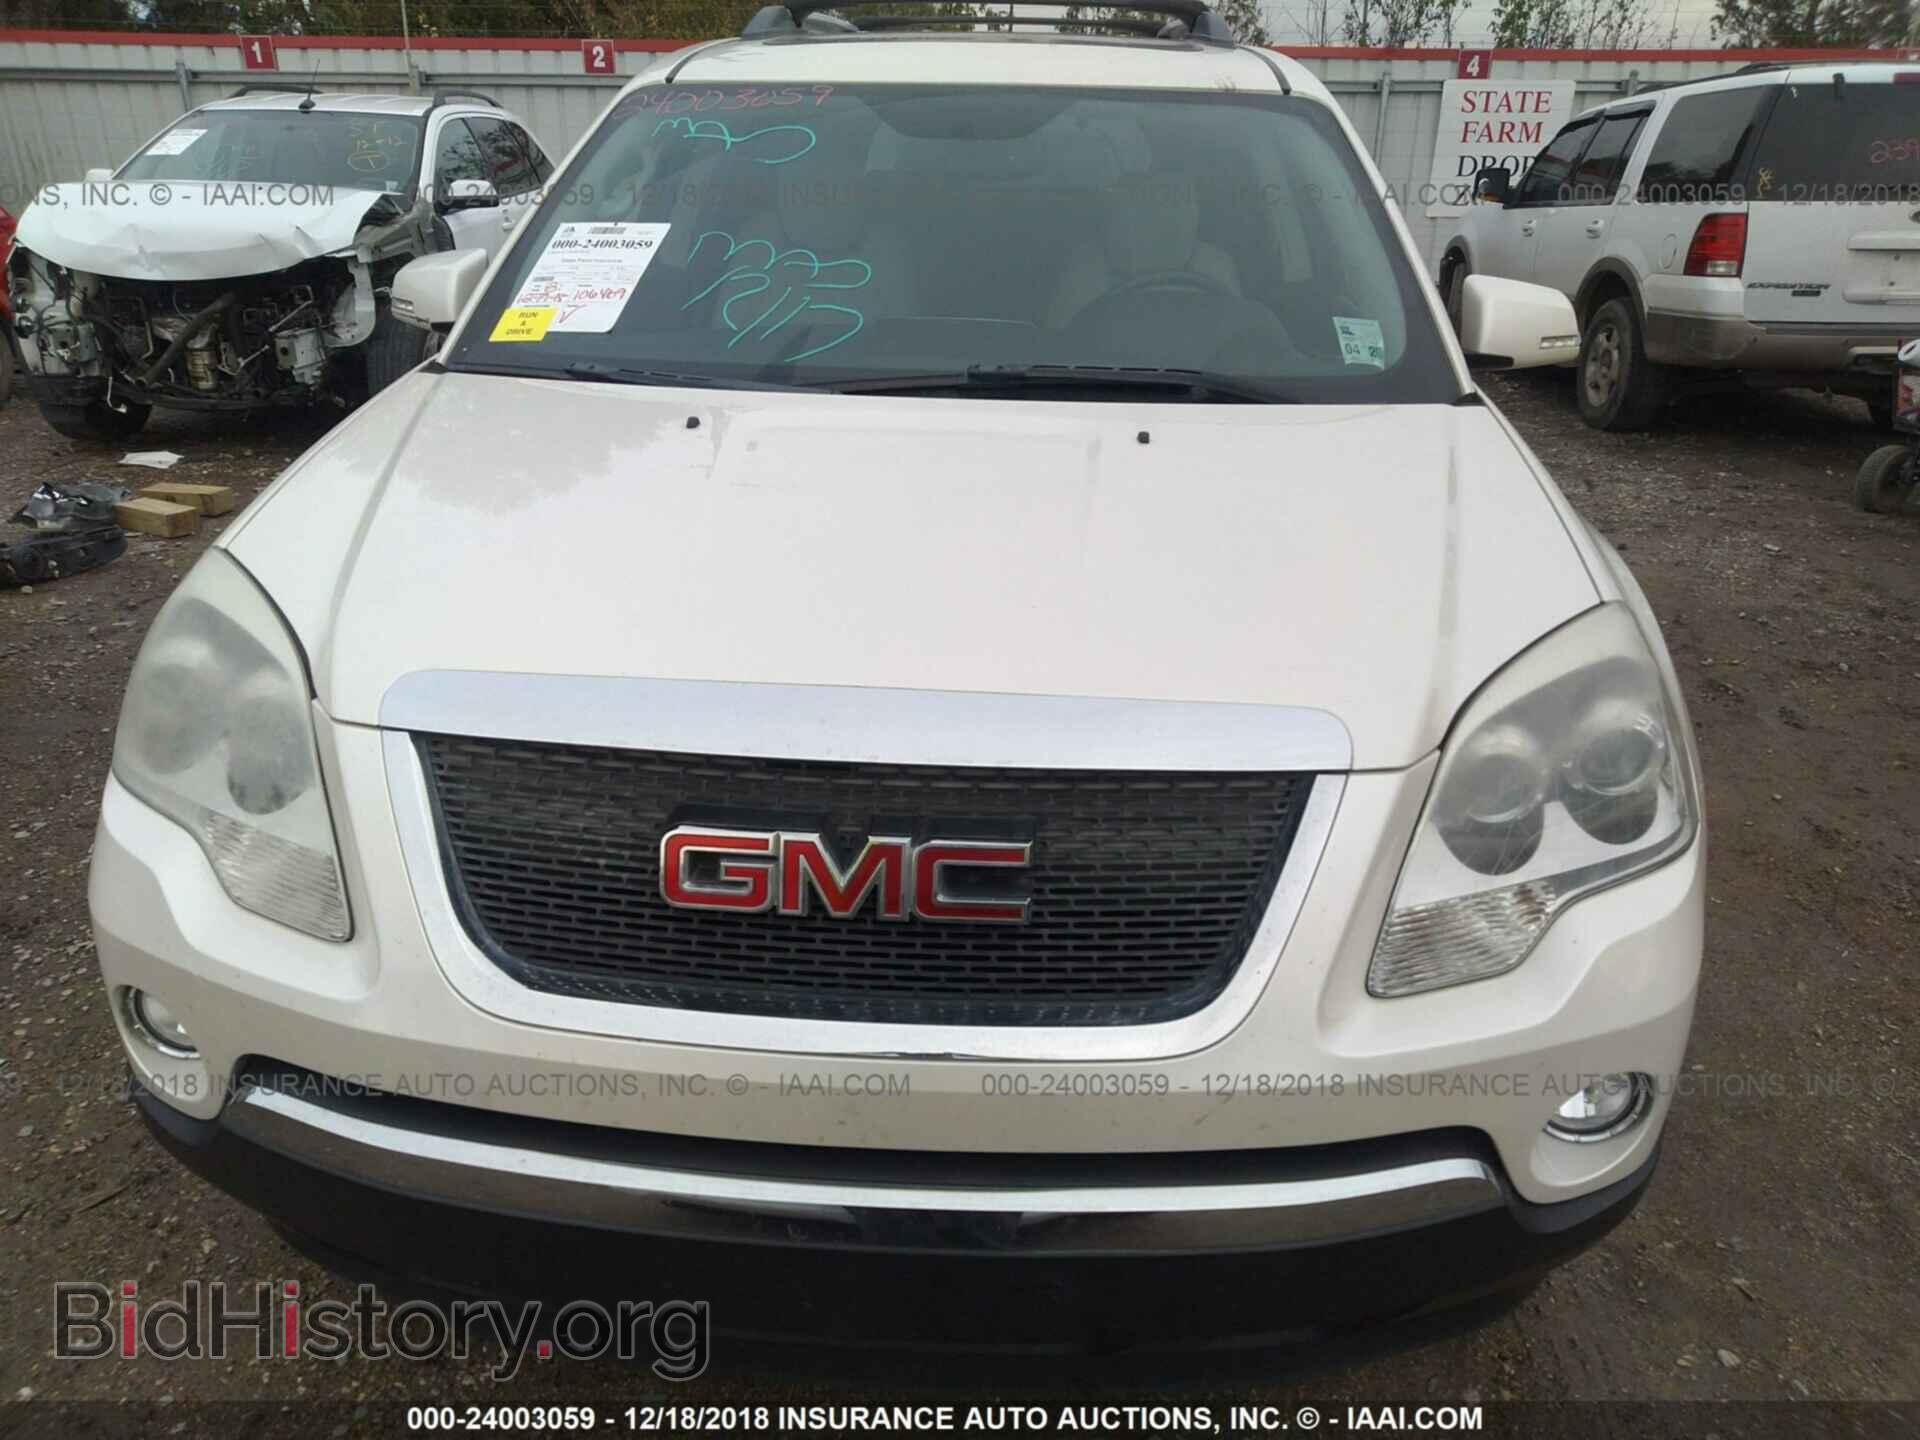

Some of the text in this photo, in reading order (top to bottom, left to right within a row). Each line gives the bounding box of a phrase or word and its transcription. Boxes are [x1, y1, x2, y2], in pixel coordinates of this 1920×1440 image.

[251, 41, 263, 63] 1
[592, 46, 606, 68] 2
[1466, 55, 1480, 77] 4
[1461, 90, 1553, 114] STATE
[1461, 121, 1544, 144] FARM
[551, 239, 654, 250] 000-24003059
[659, 824, 1033, 924] GMC
